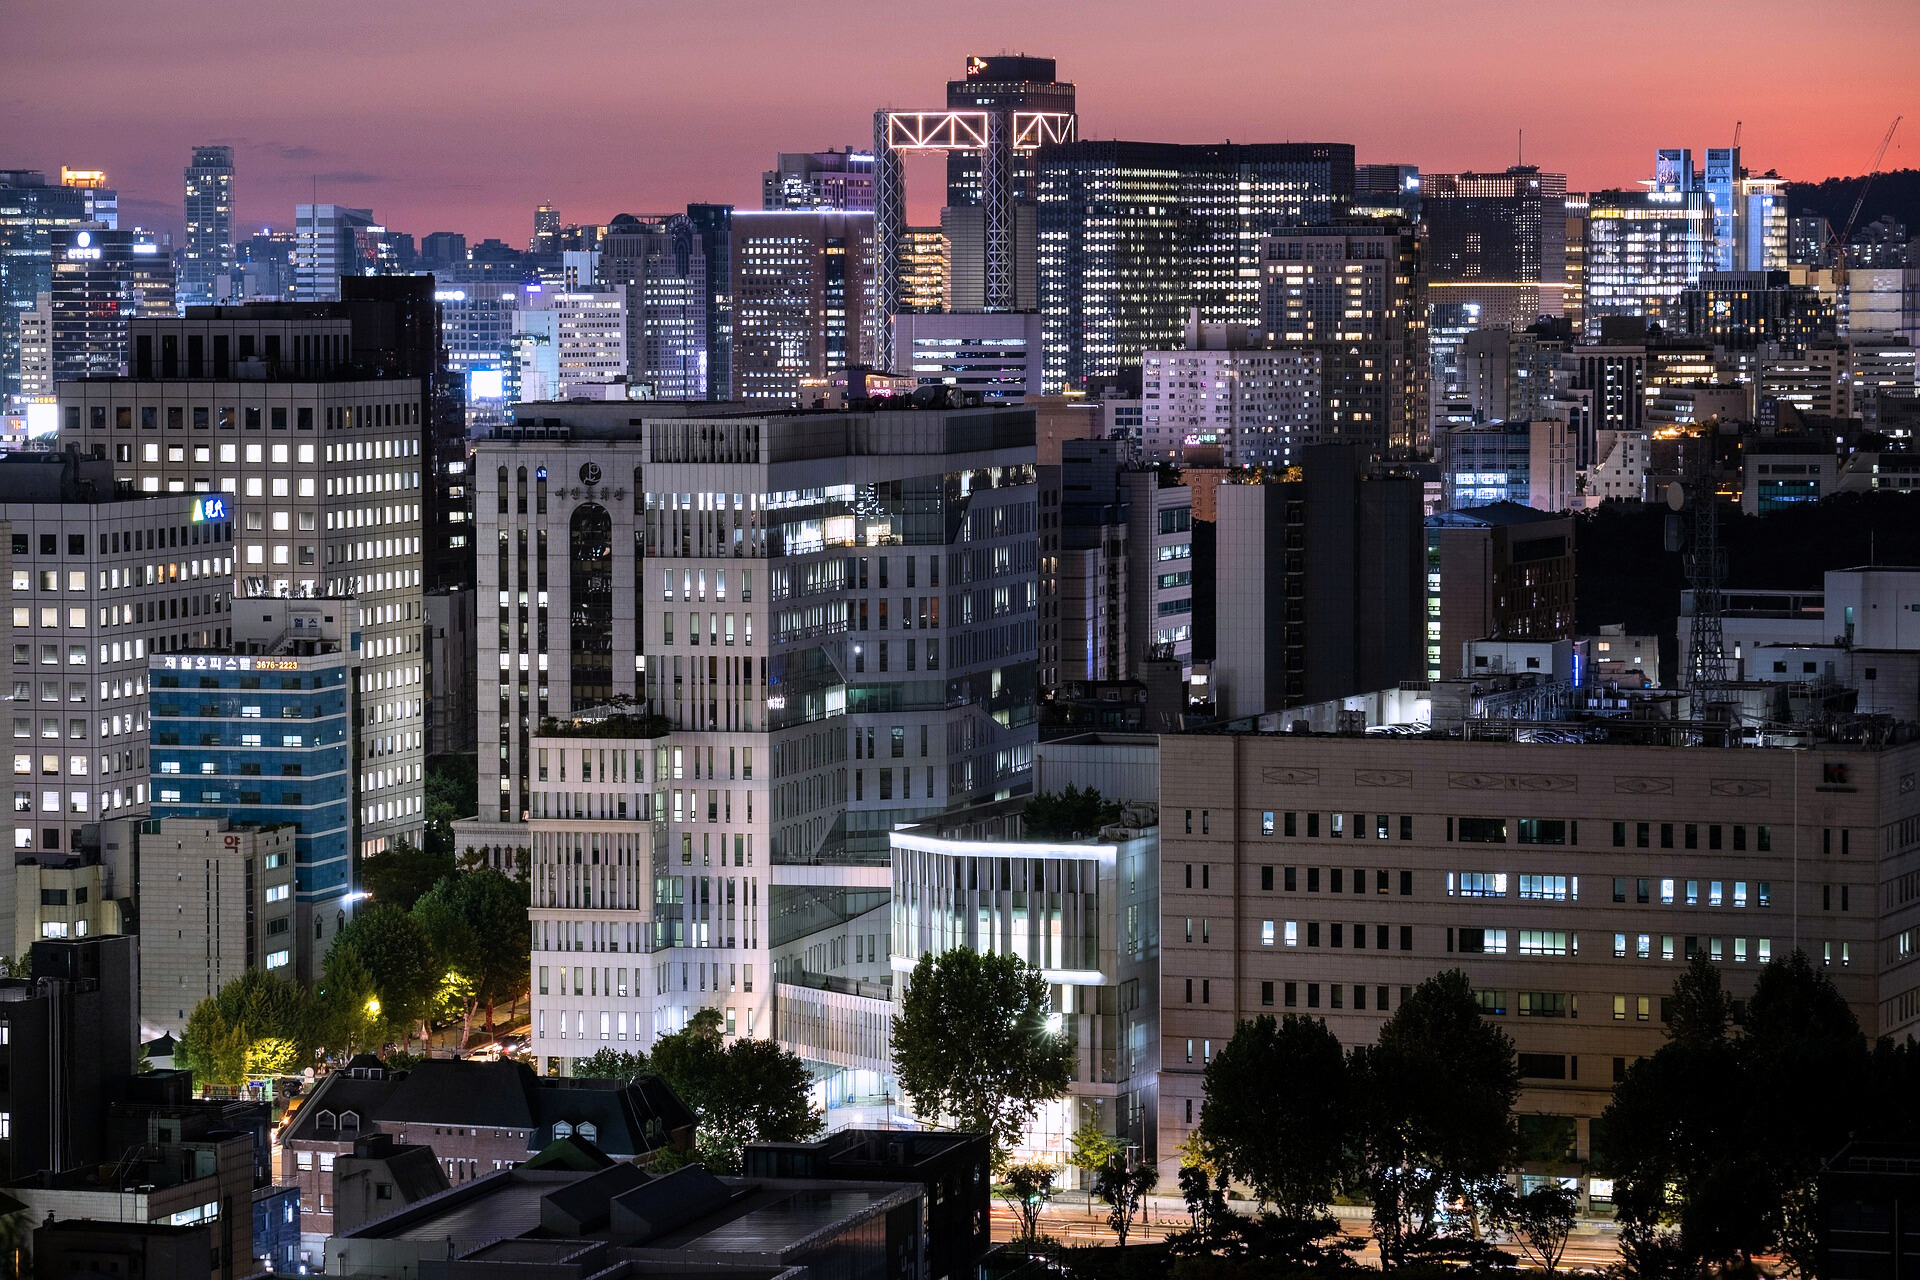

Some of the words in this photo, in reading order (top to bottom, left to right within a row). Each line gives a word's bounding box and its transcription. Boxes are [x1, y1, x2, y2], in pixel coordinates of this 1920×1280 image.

[967, 66, 979, 75] SK
[205, 499, 225, 519] 現代
[164, 656, 251, 671] 제일오피스텔
[256, 660, 298, 670] 3676-2223
[1824, 763, 1848, 784] kt
[224, 835, 241, 854] 약
